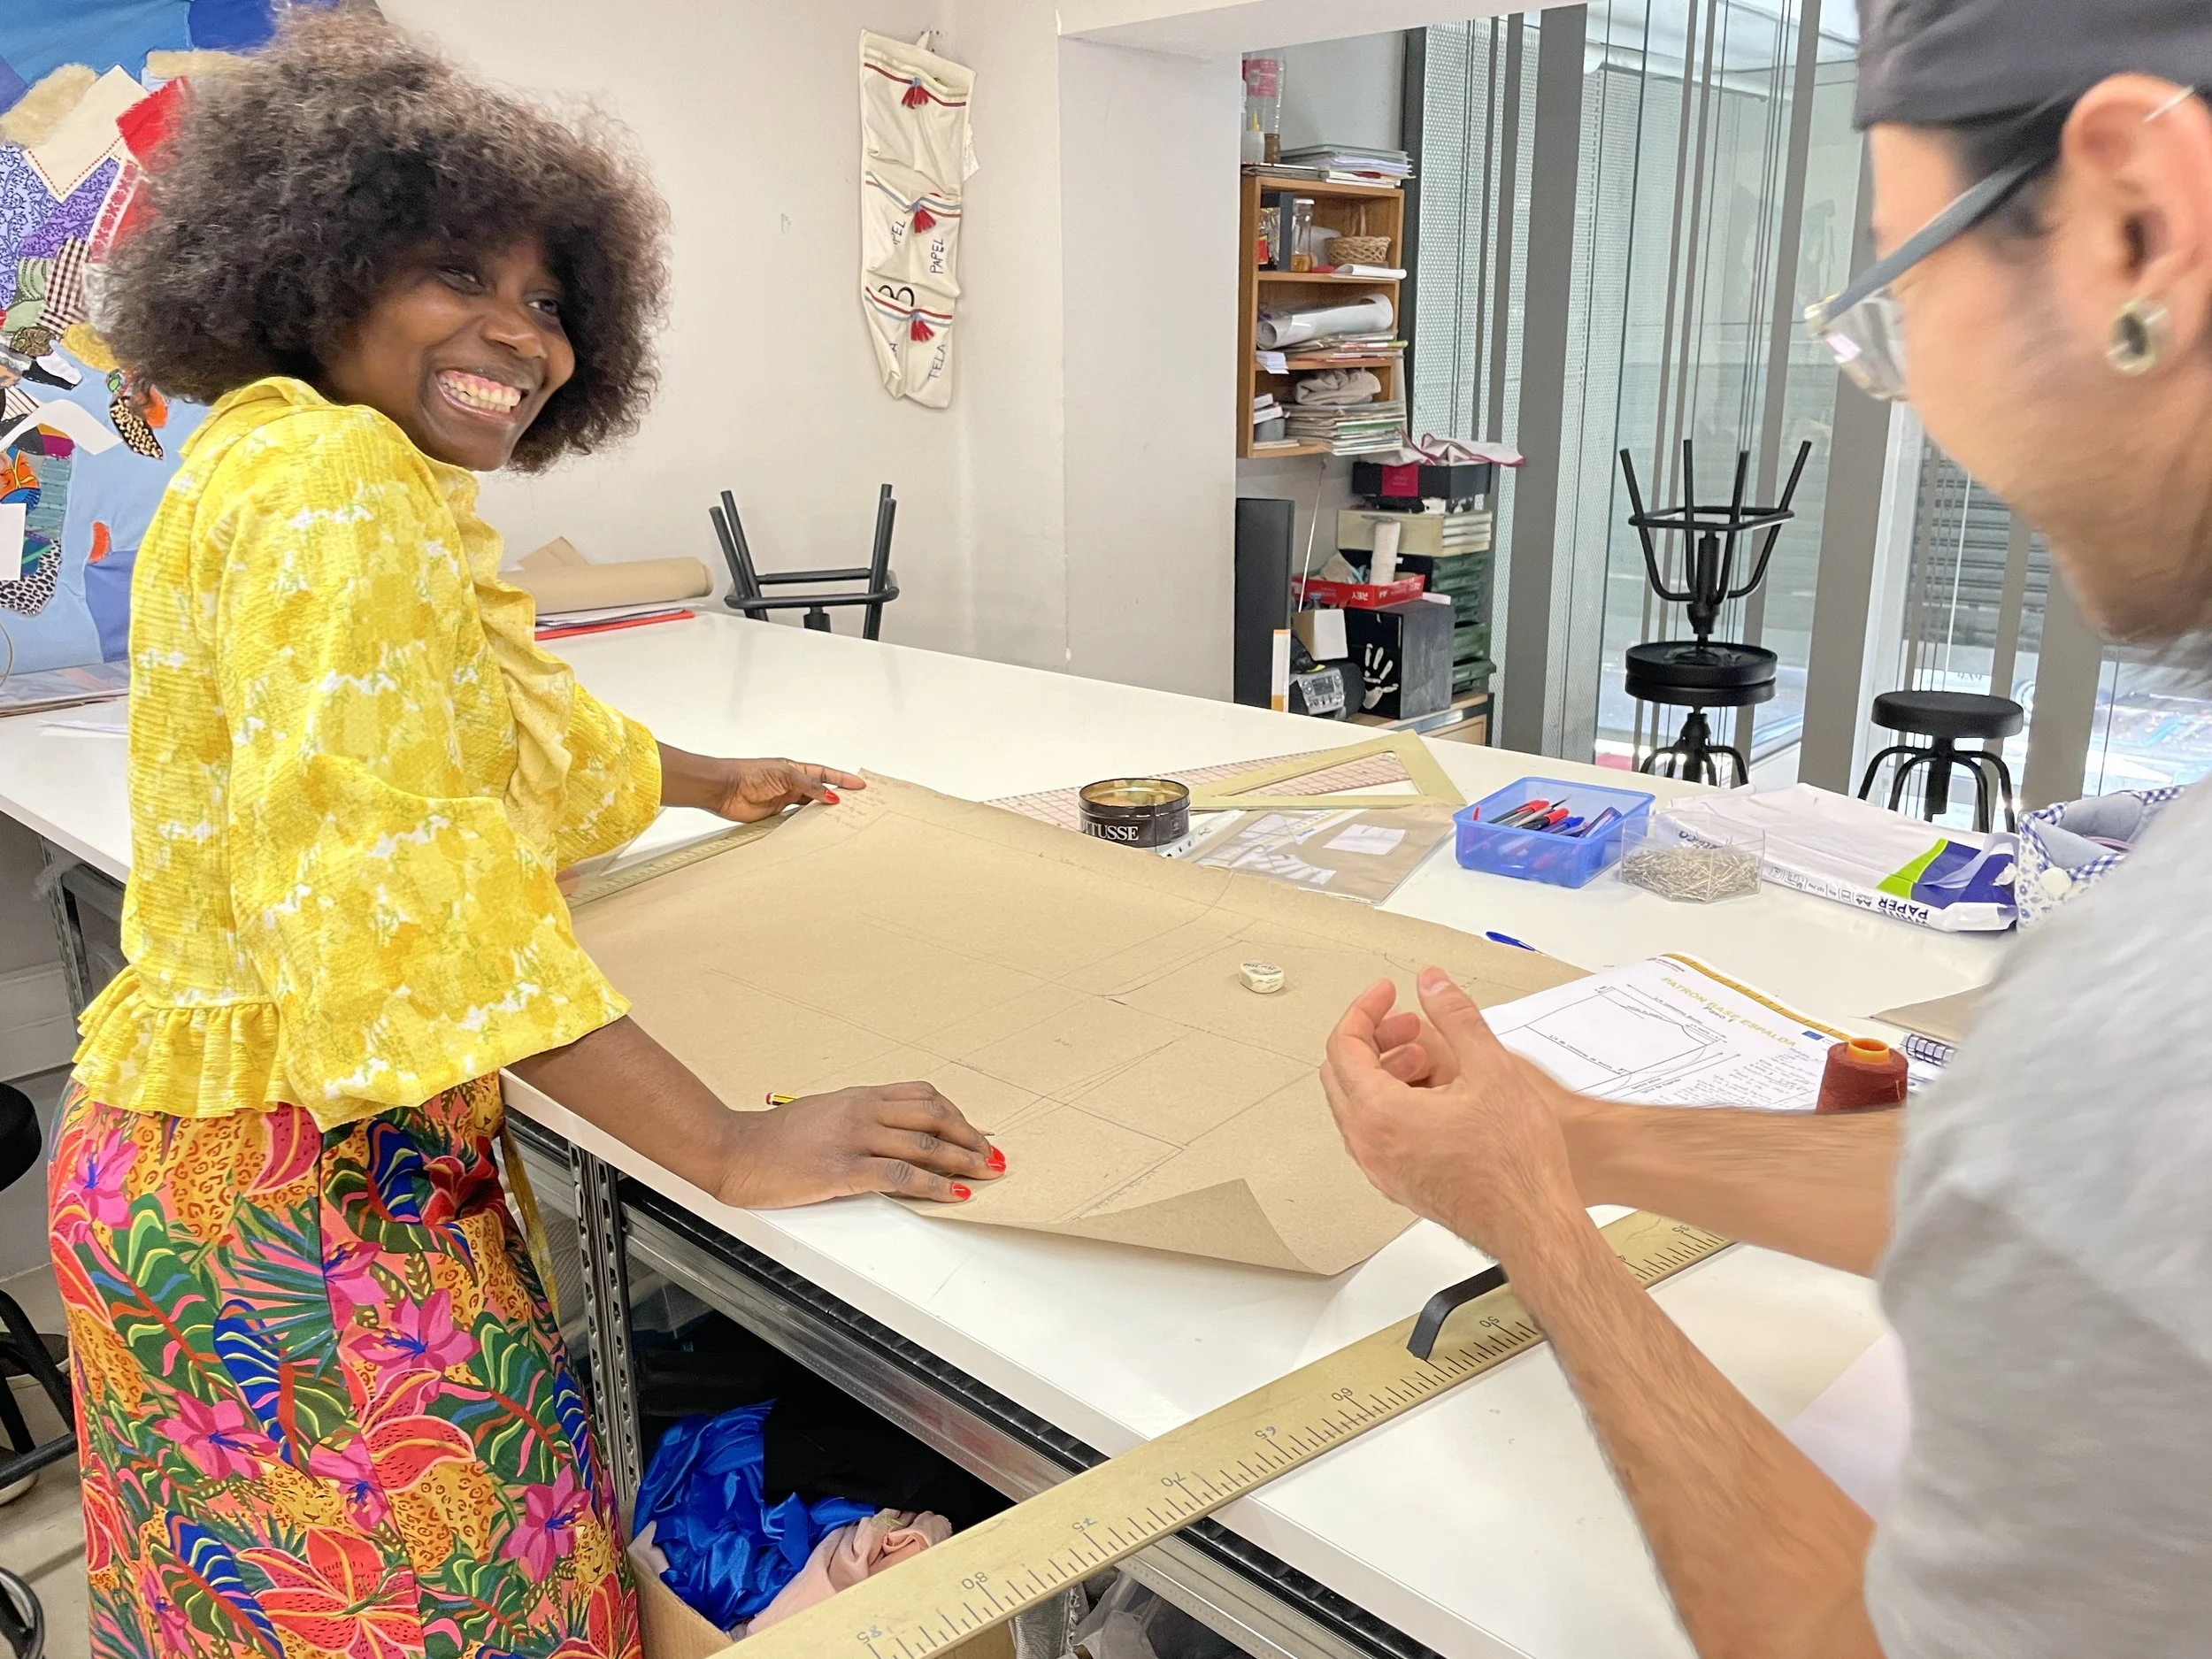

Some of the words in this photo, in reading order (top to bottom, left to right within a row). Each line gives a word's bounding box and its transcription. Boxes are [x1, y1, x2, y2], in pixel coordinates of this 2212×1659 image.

[930, 238, 944, 274] PAPEL
[927, 344, 946, 380] TELA
[1351, 590, 1369, 601] REY
[1877, 895, 1930, 920] PAPER
[1703, 1005, 1726, 1019] Paso
[1707, 1001, 1741, 1019] BASE
[1740, 1018, 1797, 1048] ESPALDA
[1671, 1225, 1690, 1234] 35
[1479, 1315, 1501, 1328] 50
[1331, 1386, 1354, 1402] 60
[1255, 1425, 1277, 1440] 65
[1160, 1471, 1187, 1488] 70
[1071, 1517, 1098, 1532] 75
[961, 1571, 988, 1590] 80
[856, 1624, 883, 1645] 85
